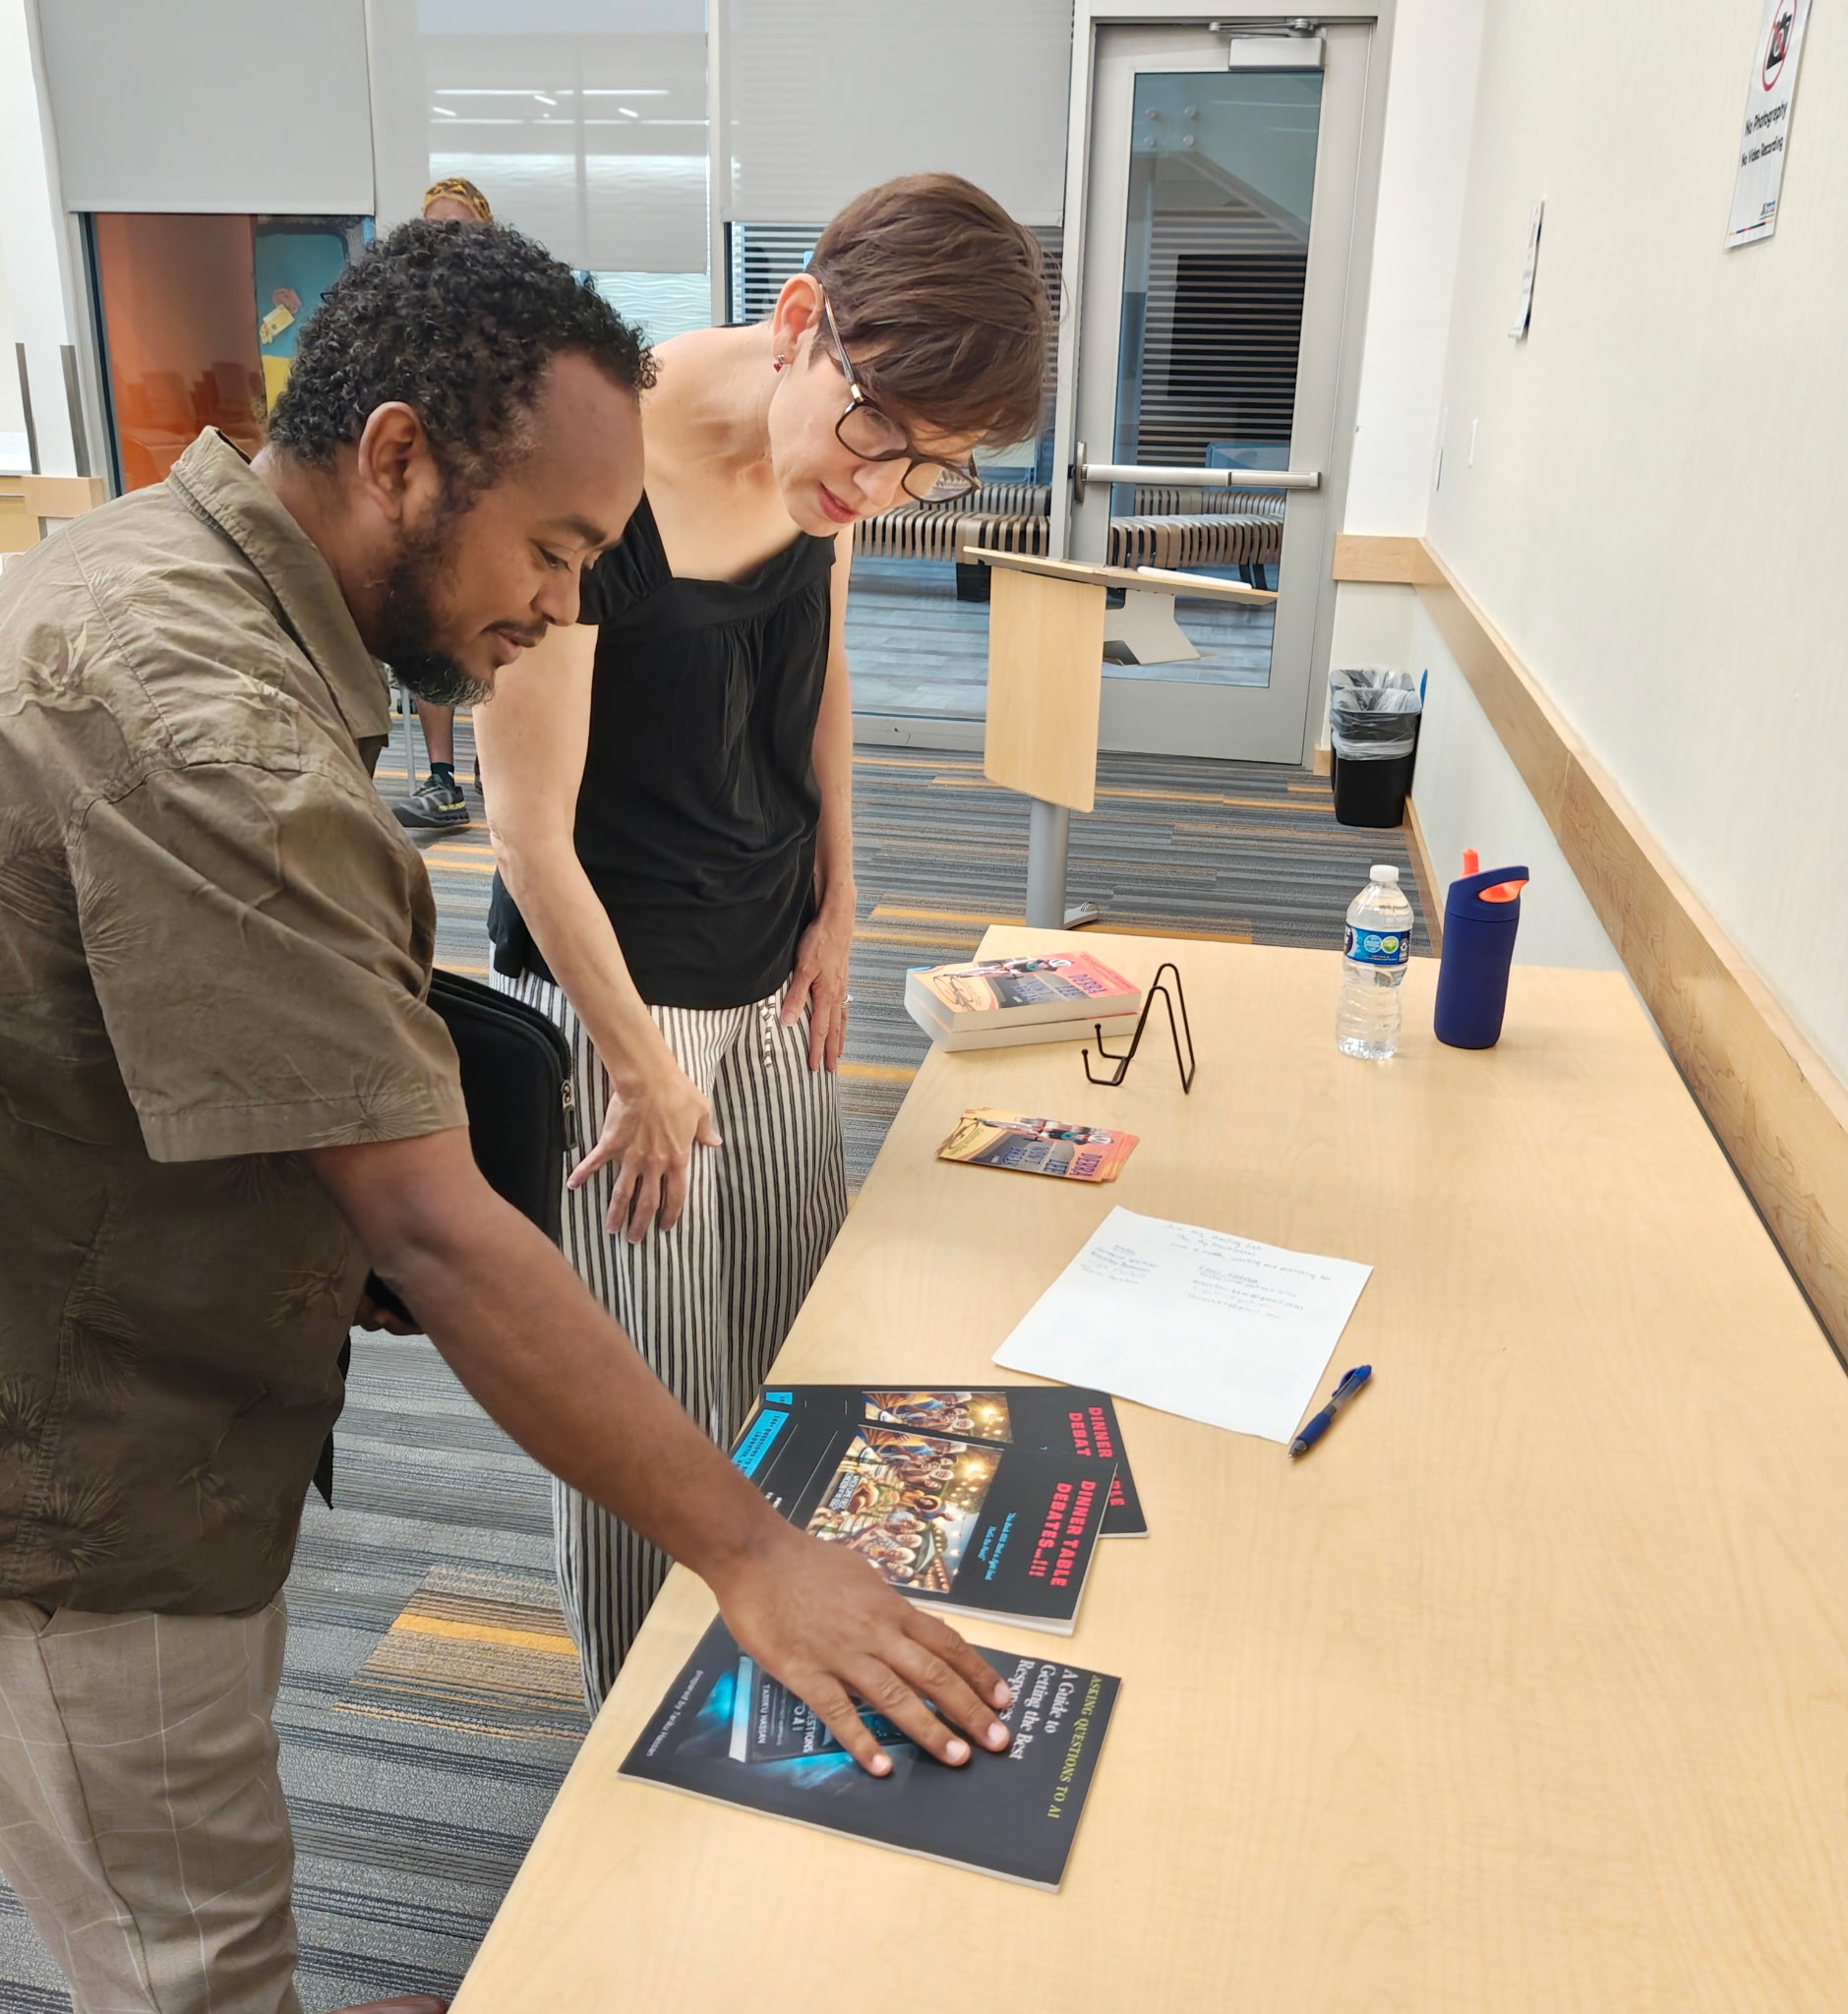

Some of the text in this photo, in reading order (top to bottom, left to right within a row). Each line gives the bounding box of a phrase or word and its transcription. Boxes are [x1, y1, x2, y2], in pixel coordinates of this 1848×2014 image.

[1745, 100, 1788, 137] No Photography
[1760, 136, 1783, 158] Recording
[1043, 1159, 1069, 1175] LEE
[1069, 1153, 1103, 1176] DEBRA
[1068, 1411, 1092, 1457] DEBAT
[1087, 1406, 1113, 1458] DINNER
[1049, 1480, 1098, 1587] DINNER TABLE
[674, 1700, 686, 1710] by
[1009, 1664, 1056, 1760] Getting the Best
[1043, 1668, 1079, 1734] A Guide to
[792, 1717, 805, 1731] AI
[1047, 1675, 1102, 1818] ASKING QUESTIONS TO AI
